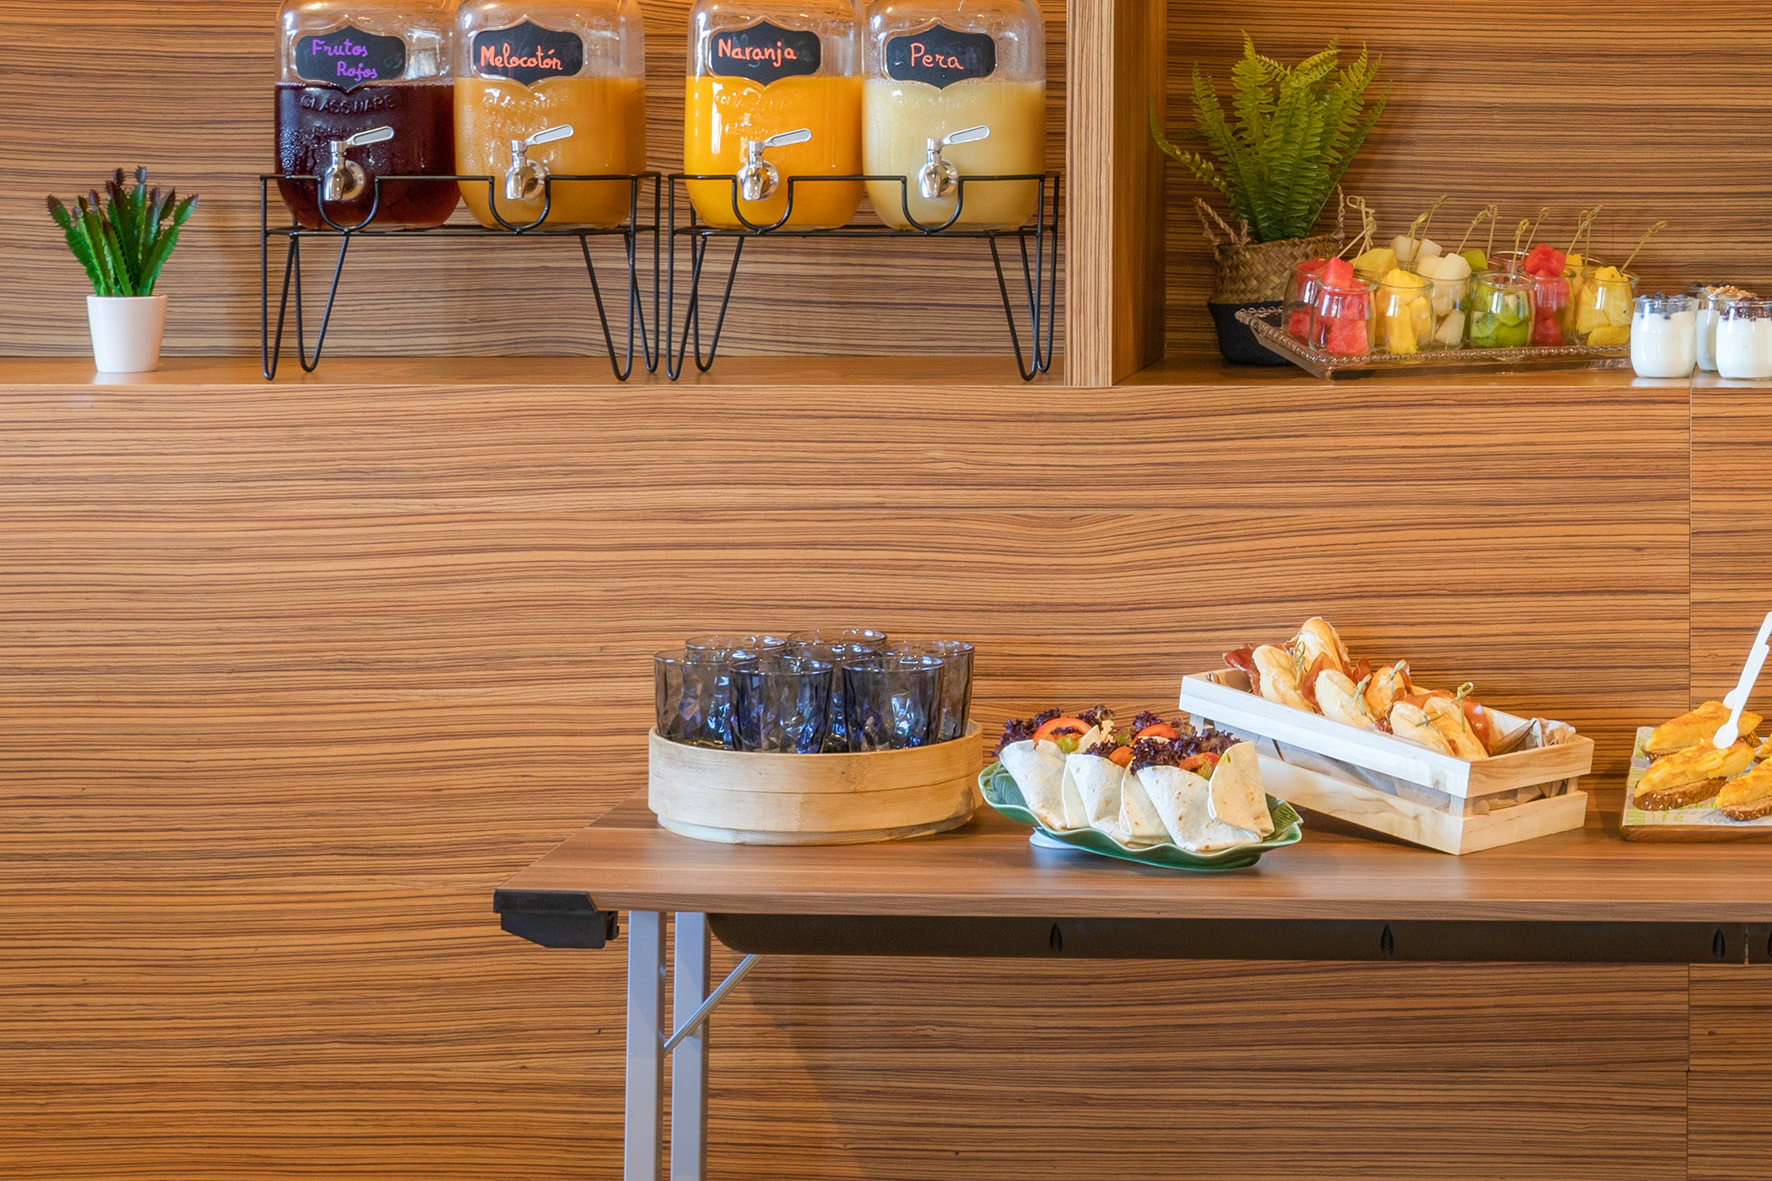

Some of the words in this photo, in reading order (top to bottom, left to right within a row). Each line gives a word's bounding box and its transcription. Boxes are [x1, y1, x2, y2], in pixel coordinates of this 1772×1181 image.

[311, 38, 369, 57] Frutos
[480, 42, 564, 71] Melocotón
[718, 38, 798, 68] Naranja
[910, 42, 964, 70] Pera
[336, 60, 378, 82] Rojos
